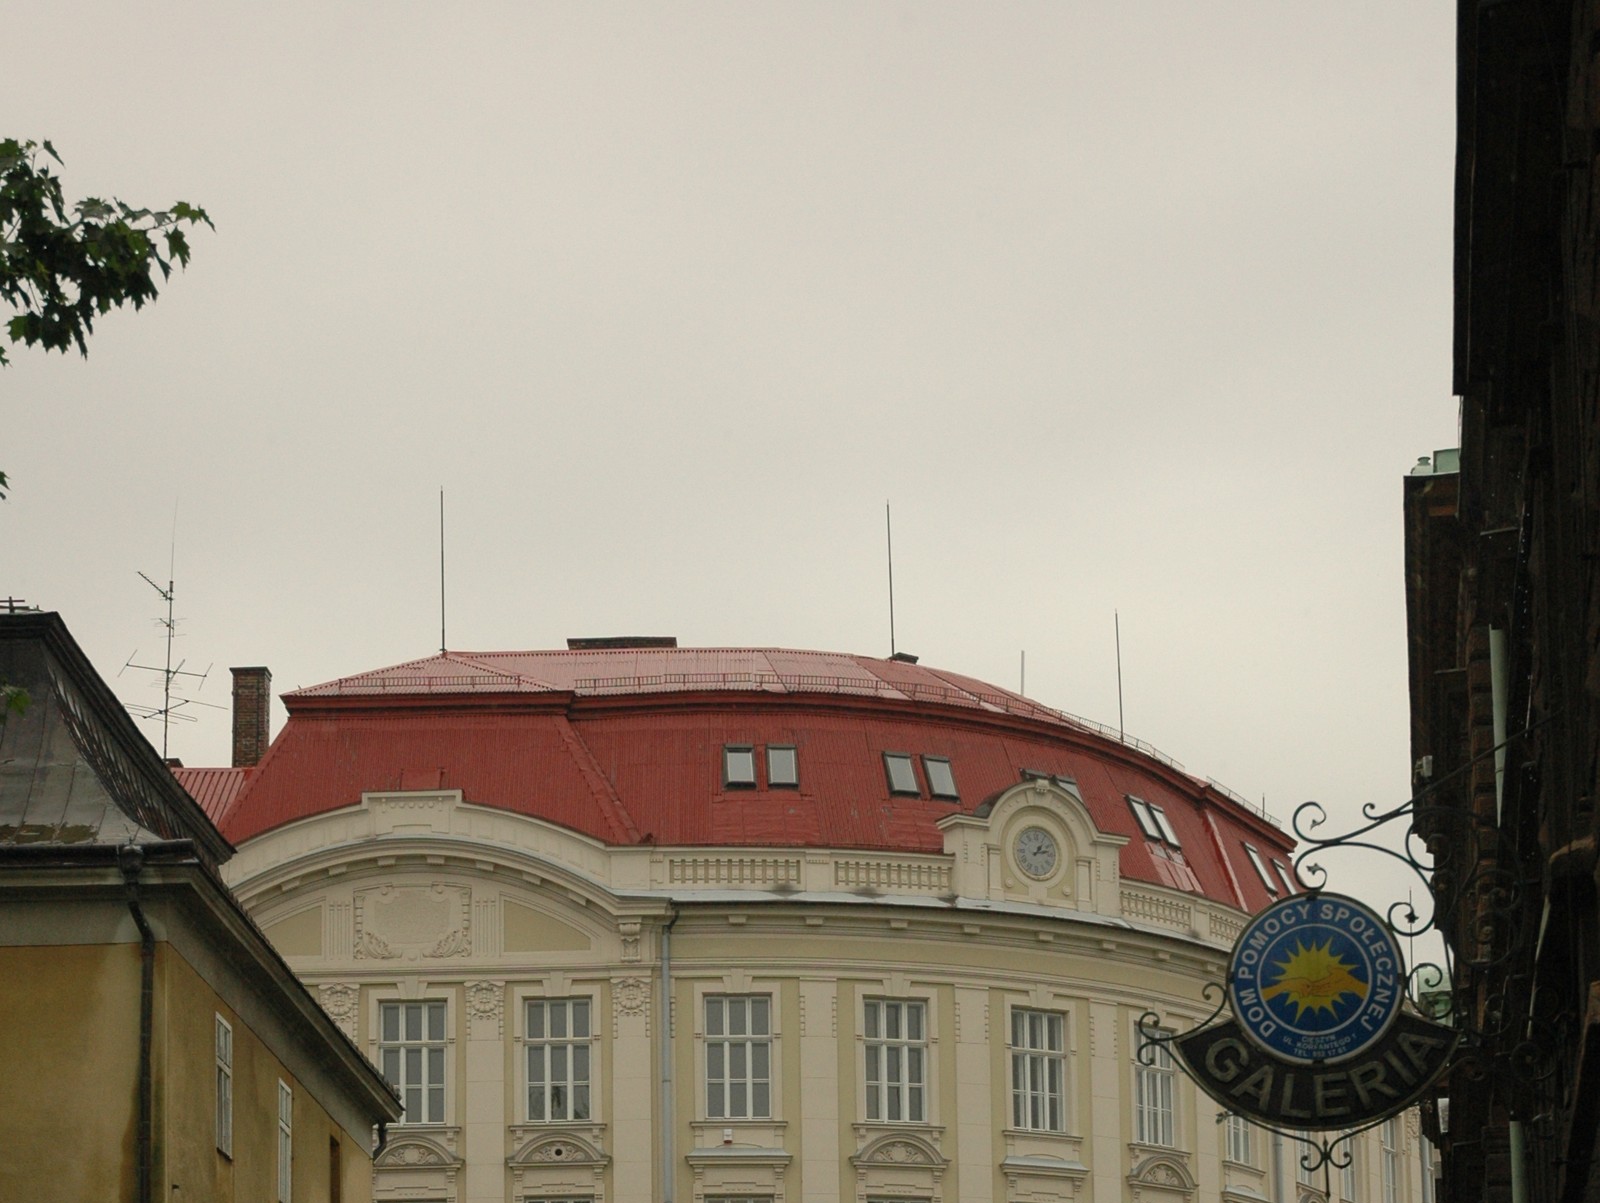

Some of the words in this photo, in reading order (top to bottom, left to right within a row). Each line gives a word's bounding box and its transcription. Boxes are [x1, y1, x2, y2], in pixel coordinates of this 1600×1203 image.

[1238, 904, 1311, 979] POMOCY
[1320, 904, 1394, 1031] SPOŁECZNEJ
[1239, 987, 1277, 1037] DOM
[1302, 1034, 1336, 1043] CIESZYN
[1205, 1032, 1447, 1119] GALERIA
